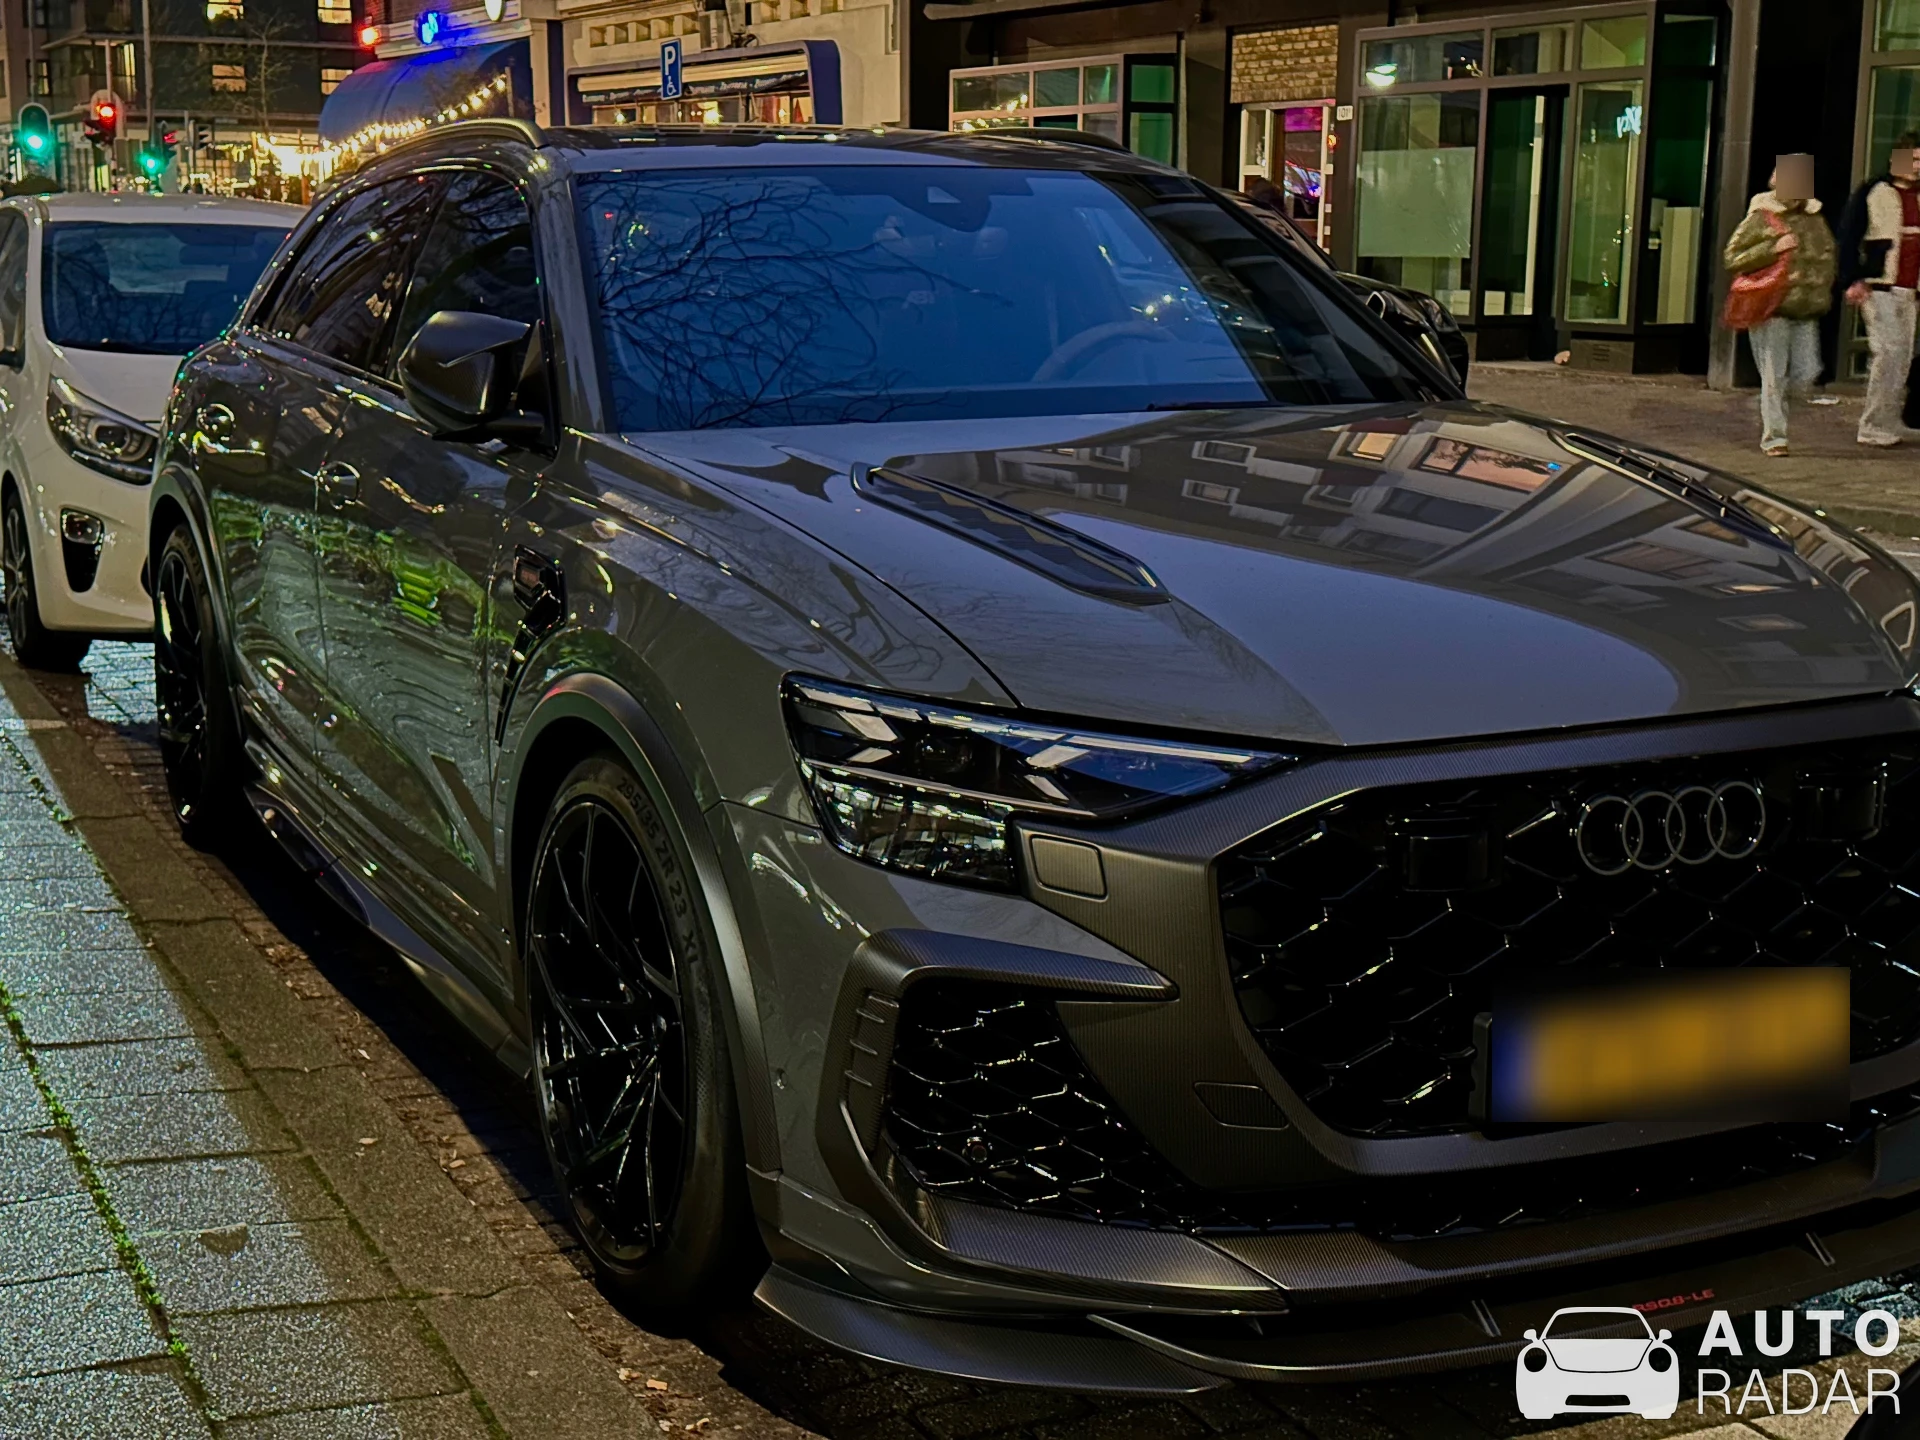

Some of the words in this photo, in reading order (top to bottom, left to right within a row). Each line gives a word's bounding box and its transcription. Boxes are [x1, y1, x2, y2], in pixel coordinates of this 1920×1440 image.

[665, 46, 676, 75] P
[616, 777, 660, 840] 295/35
[655, 841, 674, 879] ZR
[669, 880, 687, 918] 23
